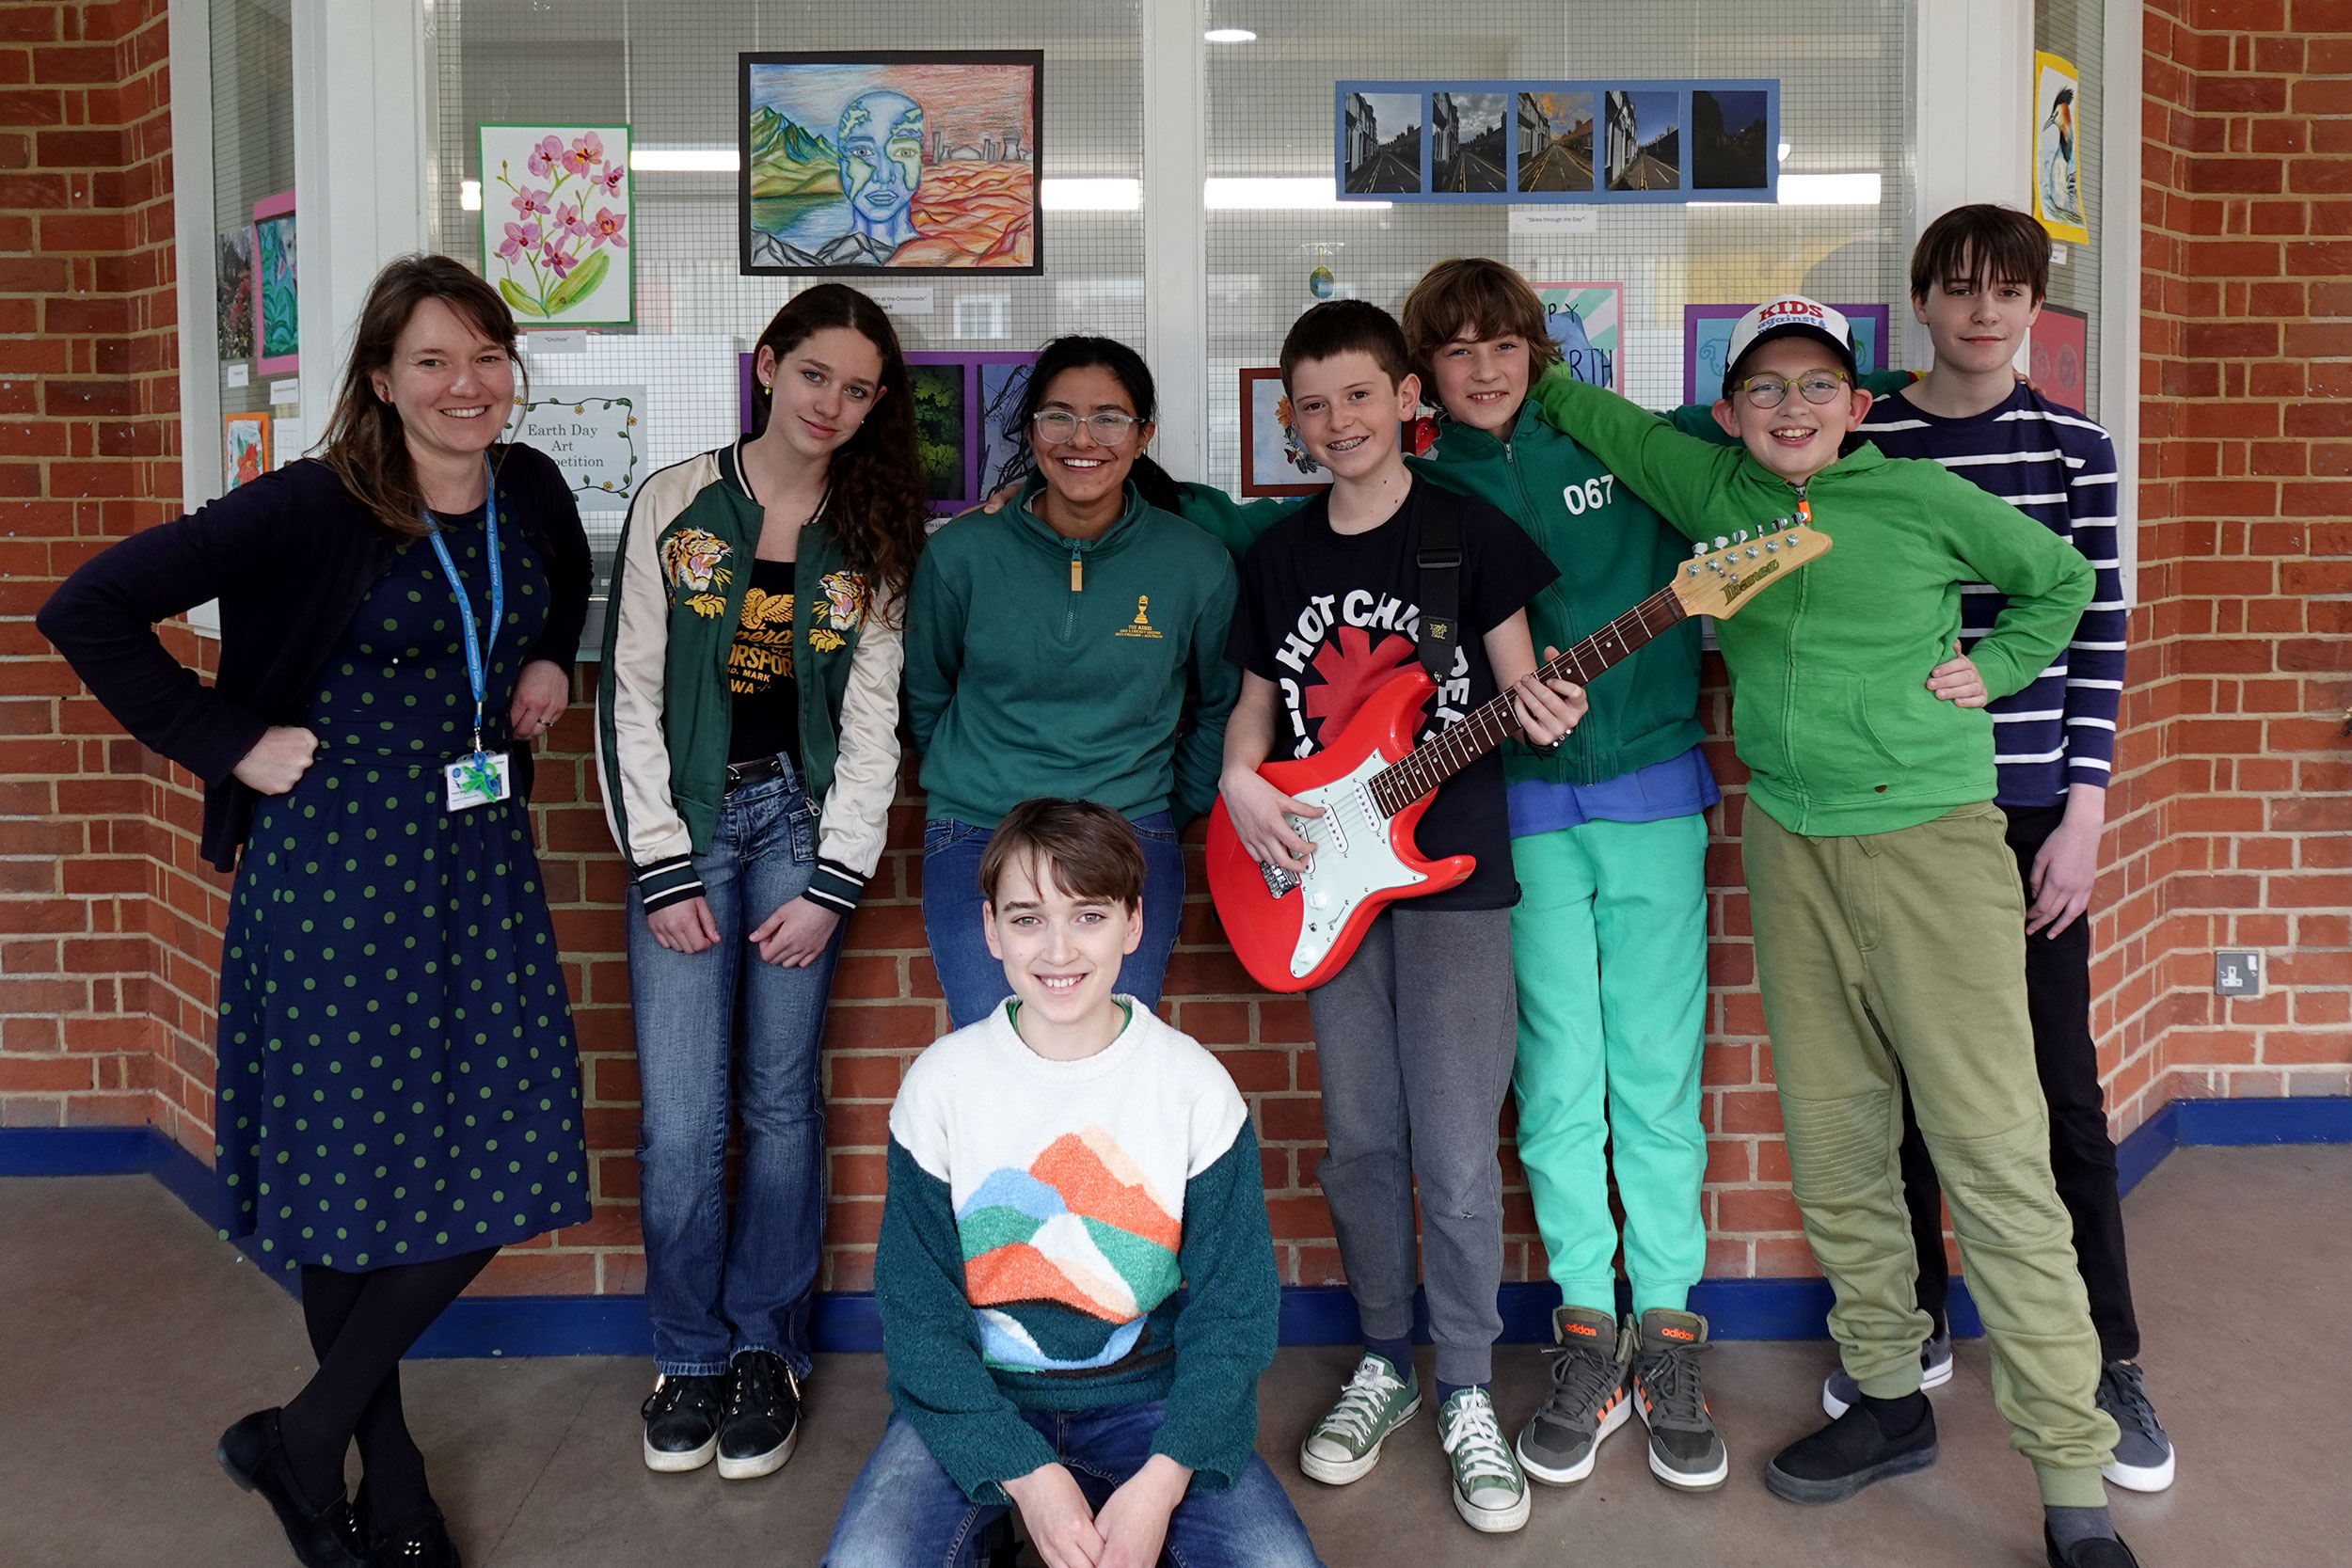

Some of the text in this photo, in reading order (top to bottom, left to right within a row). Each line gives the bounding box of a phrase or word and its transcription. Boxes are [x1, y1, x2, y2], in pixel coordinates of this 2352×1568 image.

[1758, 301, 1824, 323] KIDS
[1757, 315, 1817, 329] against
[527, 423, 598, 438] Earth Day
[551, 440, 574, 451] Art
[553, 455, 604, 467] petition
[1563, 474, 1614, 515] 067
[488, 531, 497, 564] Community
[433, 535, 460, 587] Community College
[1719, 558, 1780, 607] Ibanez
[1275, 594, 1335, 674] HOT
[464, 610, 481, 693] Parkside Community College
[742, 668, 771, 683] MARK
[1565, 1323, 1597, 1337] adidas
[1661, 1327, 1694, 1341] adidas
